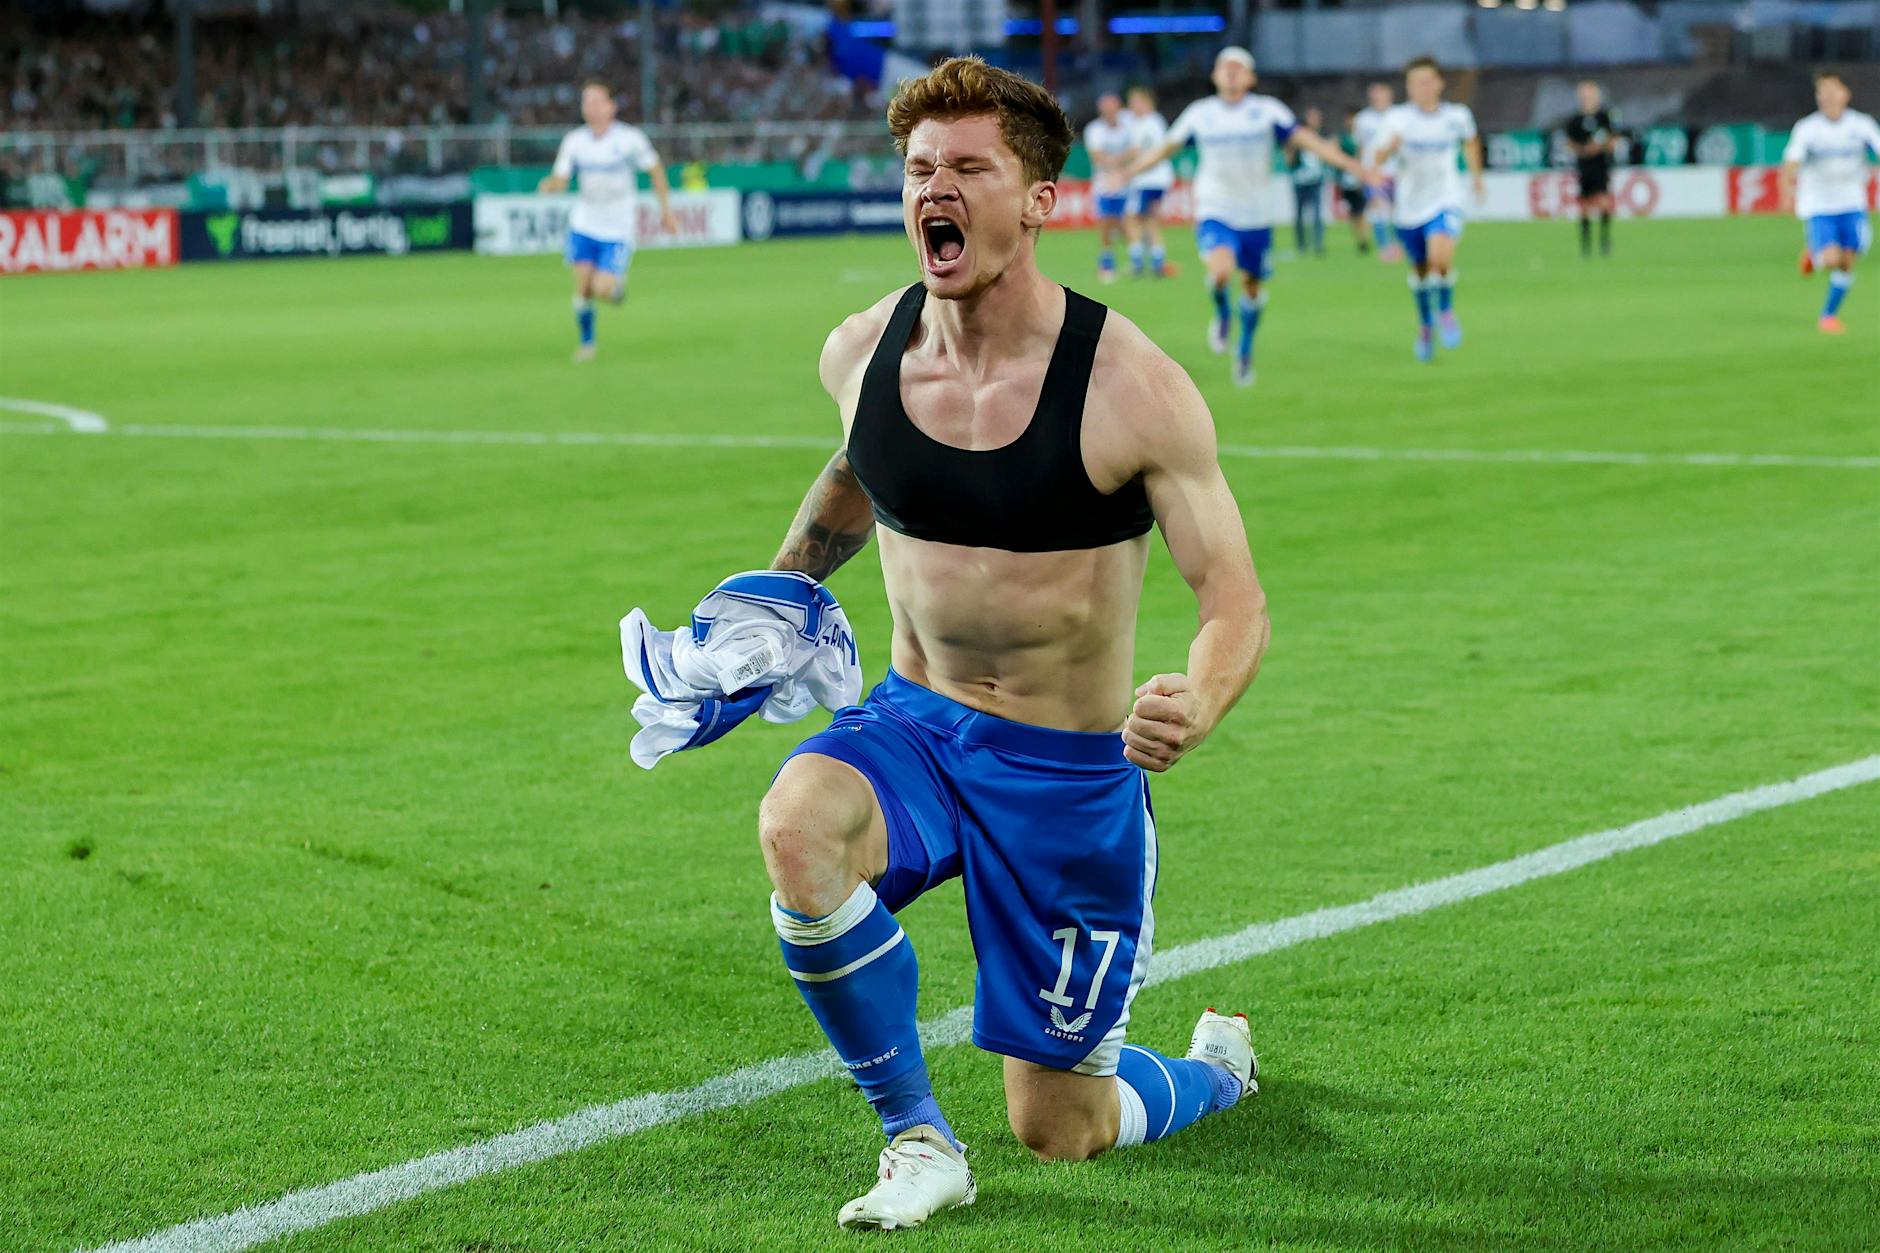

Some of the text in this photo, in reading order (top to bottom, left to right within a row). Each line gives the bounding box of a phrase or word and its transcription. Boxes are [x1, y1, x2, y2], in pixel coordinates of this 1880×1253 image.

[1529, 170, 1660, 218] ERO
[1039, 927, 1120, 1010] 17
[1205, 1042, 1228, 1056] FURON
